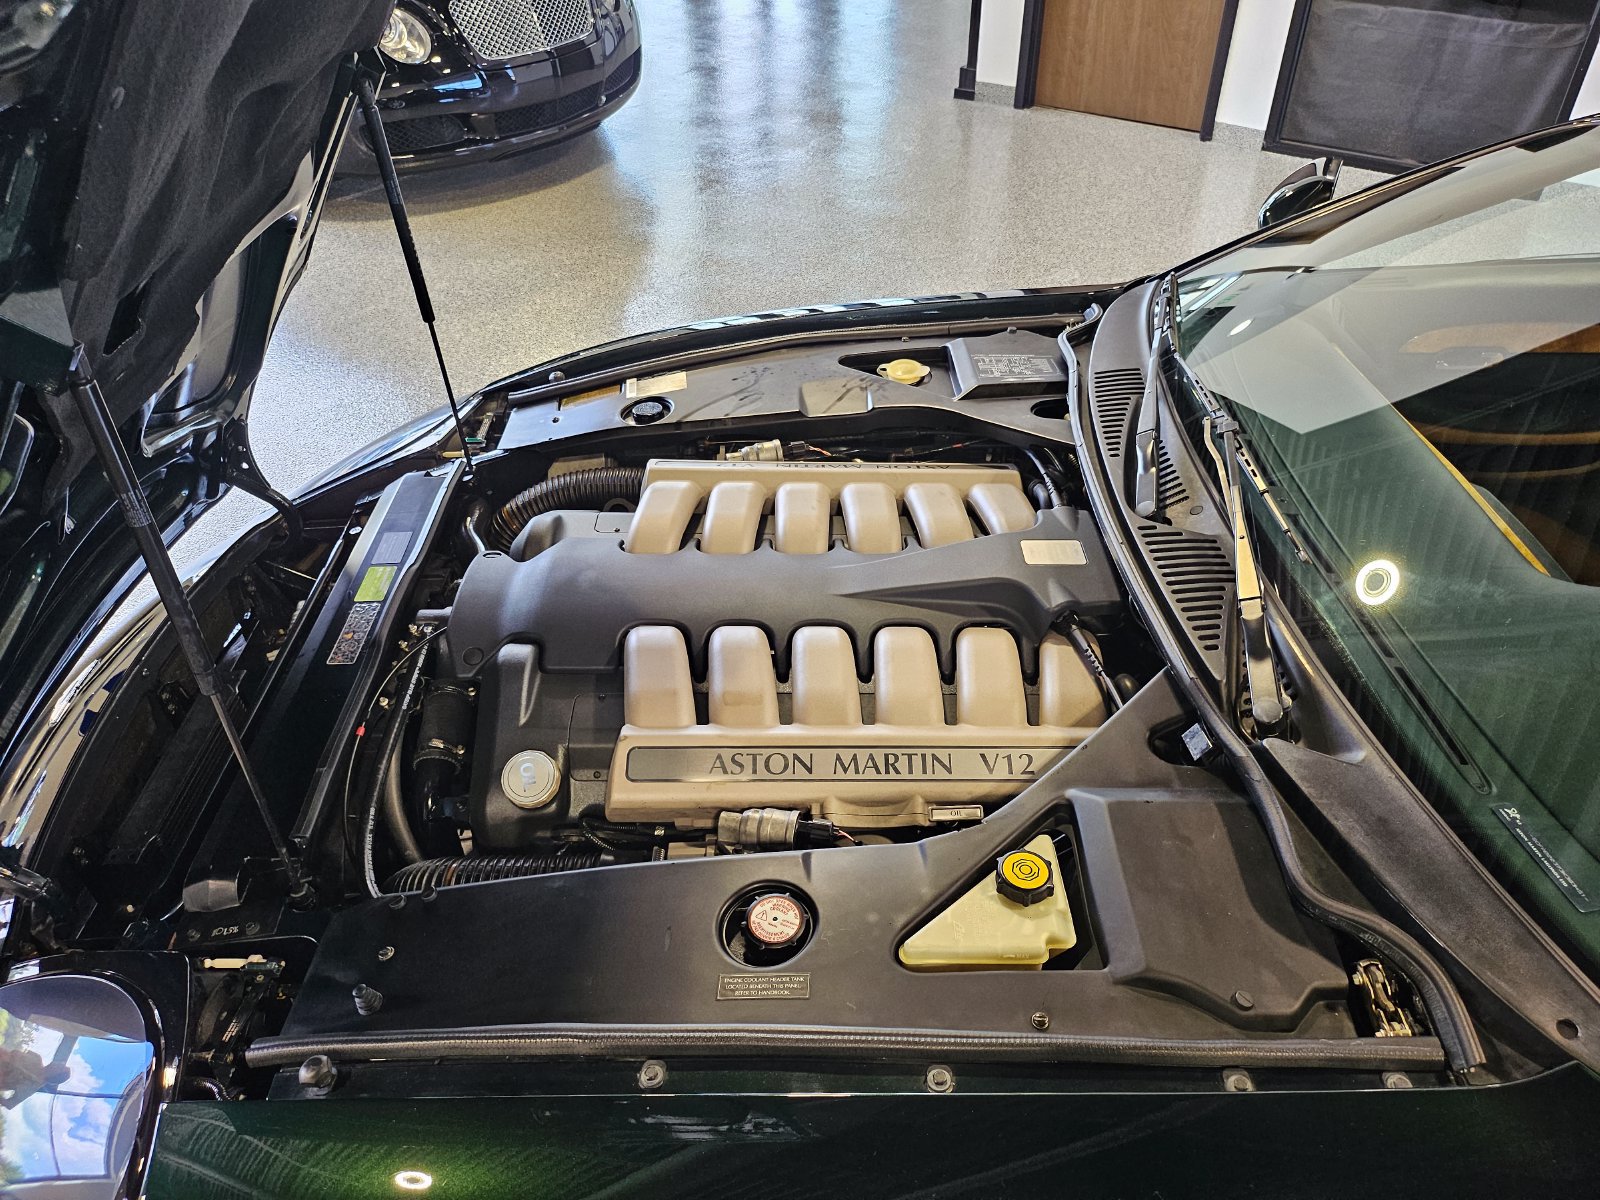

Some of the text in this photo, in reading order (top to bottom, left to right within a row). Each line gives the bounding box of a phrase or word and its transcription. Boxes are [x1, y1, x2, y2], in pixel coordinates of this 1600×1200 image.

[709, 753, 1036, 775] ASTON MARTIN V12
